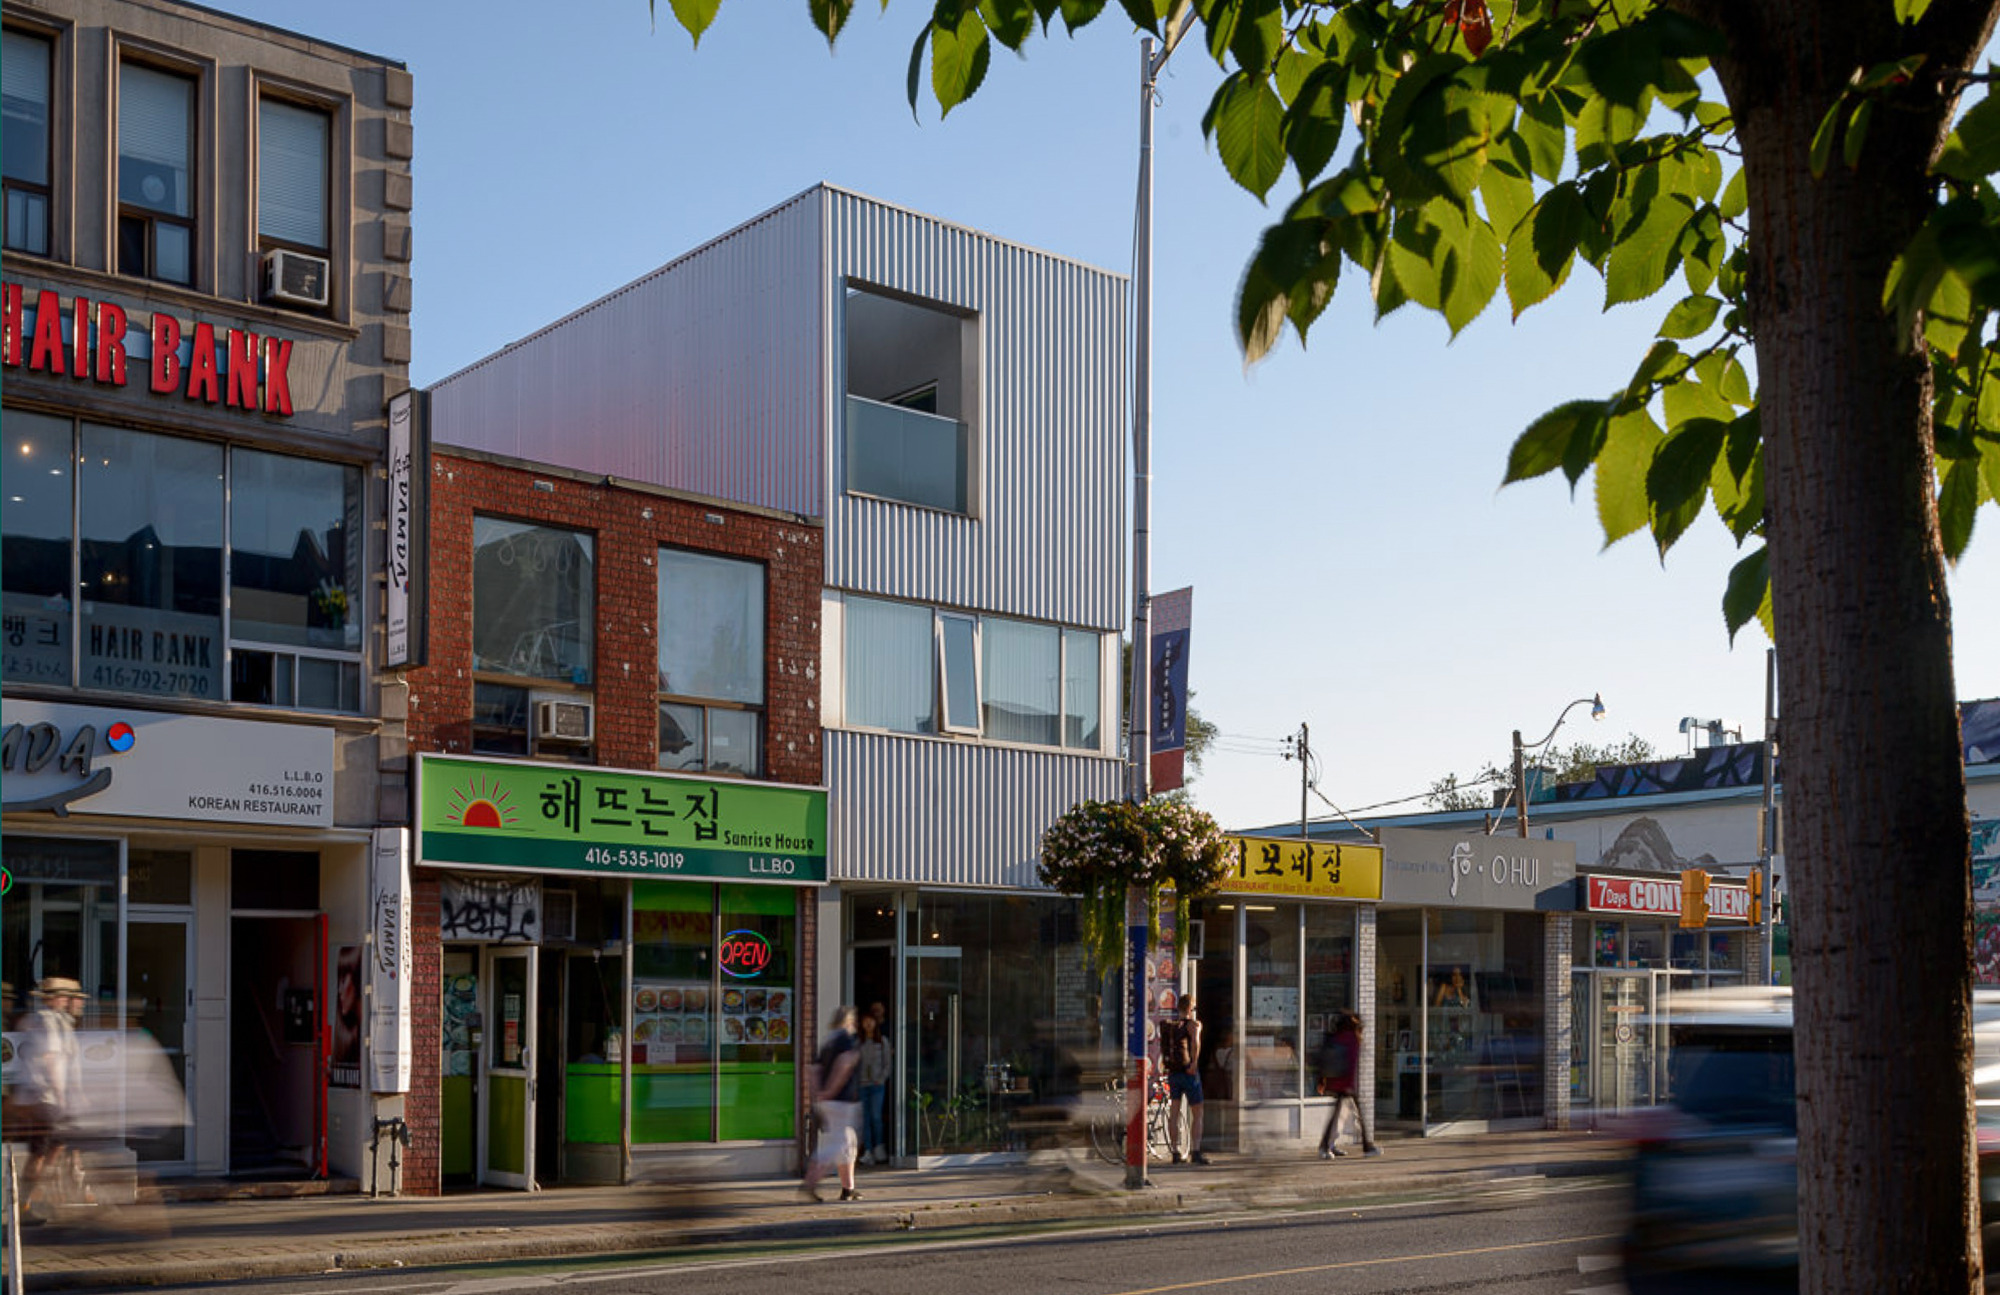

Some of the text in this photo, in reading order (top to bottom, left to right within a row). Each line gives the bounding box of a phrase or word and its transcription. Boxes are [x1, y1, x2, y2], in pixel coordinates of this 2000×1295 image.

[2, 282, 293, 416] HAIR BANK
[91, 624, 211, 668] HAIR BANK
[93, 664, 208, 695] 416-792-7020
[249, 783, 322, 799] 416.516.0004
[188, 795, 323, 816] KOREAN RESTAURANT
[724, 829, 814, 851] Sunrise House
[585, 847, 684, 870] 416-535-1019
[1597, 881, 1608, 907] 7
[720, 941, 767, 966] OPEN
